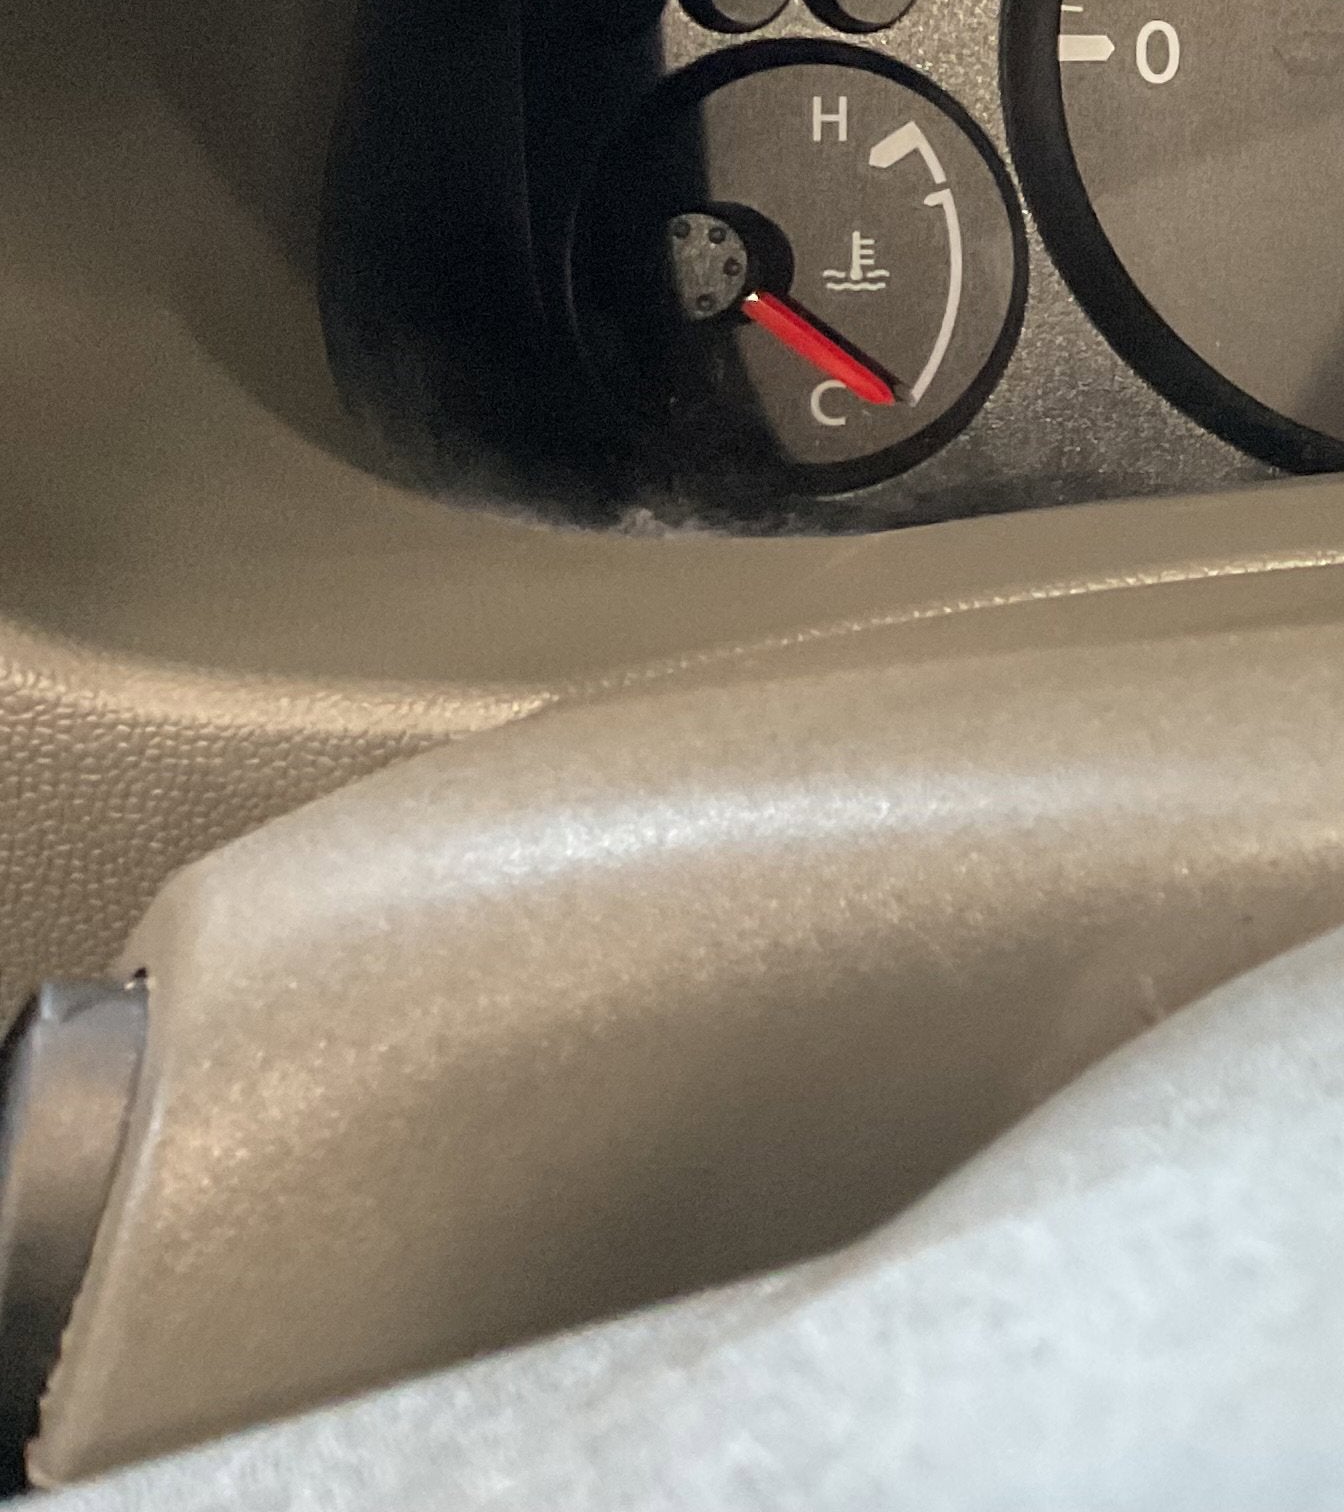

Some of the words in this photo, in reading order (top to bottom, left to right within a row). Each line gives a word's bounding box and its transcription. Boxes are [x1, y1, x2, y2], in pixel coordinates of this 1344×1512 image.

[1135, 21, 1180, 85] 0
[812, 95, 848, 142] H
[810, 379, 848, 426] C
